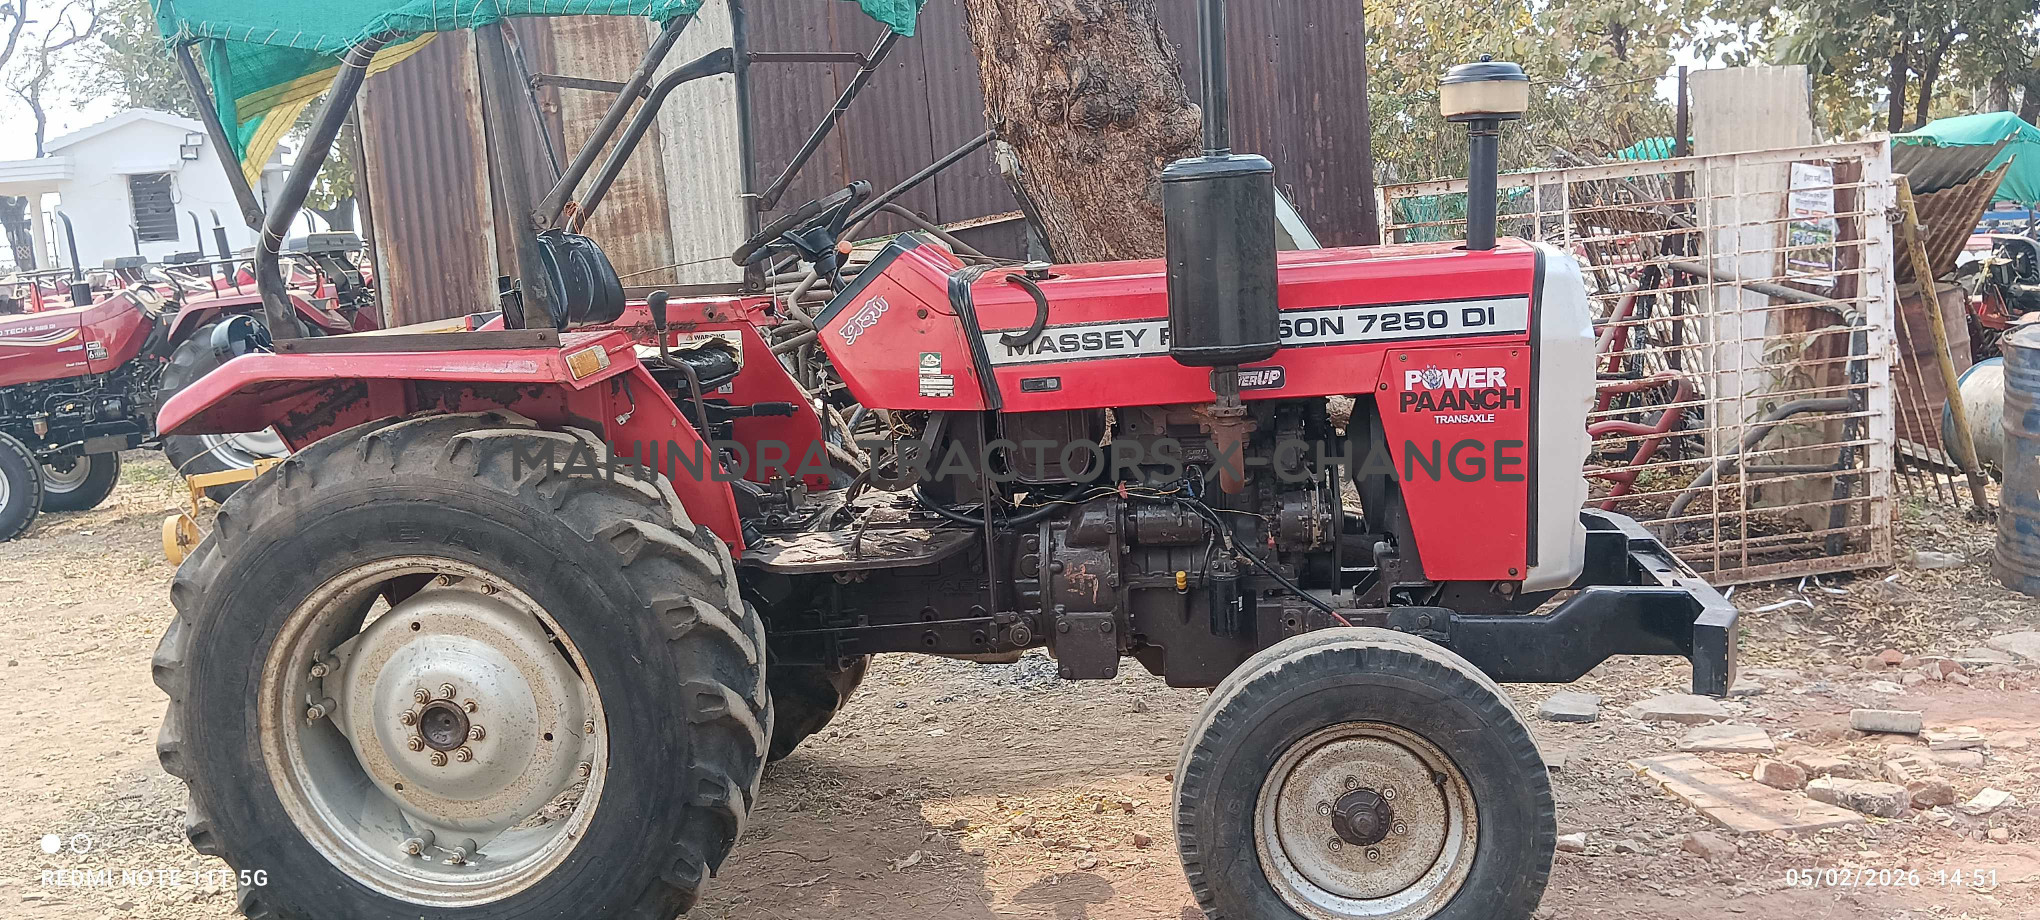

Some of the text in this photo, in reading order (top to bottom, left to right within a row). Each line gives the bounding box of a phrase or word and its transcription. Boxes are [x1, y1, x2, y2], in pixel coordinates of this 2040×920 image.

[1007, 328, 1147, 356] MASSEY
[1357, 309, 1449, 334] 7250
[1462, 307, 1496, 327] DI
[1404, 366, 1507, 391] POWER
[1400, 387, 1521, 413] PAANCH
[1434, 414, 1495, 424] TRANSAXLE
